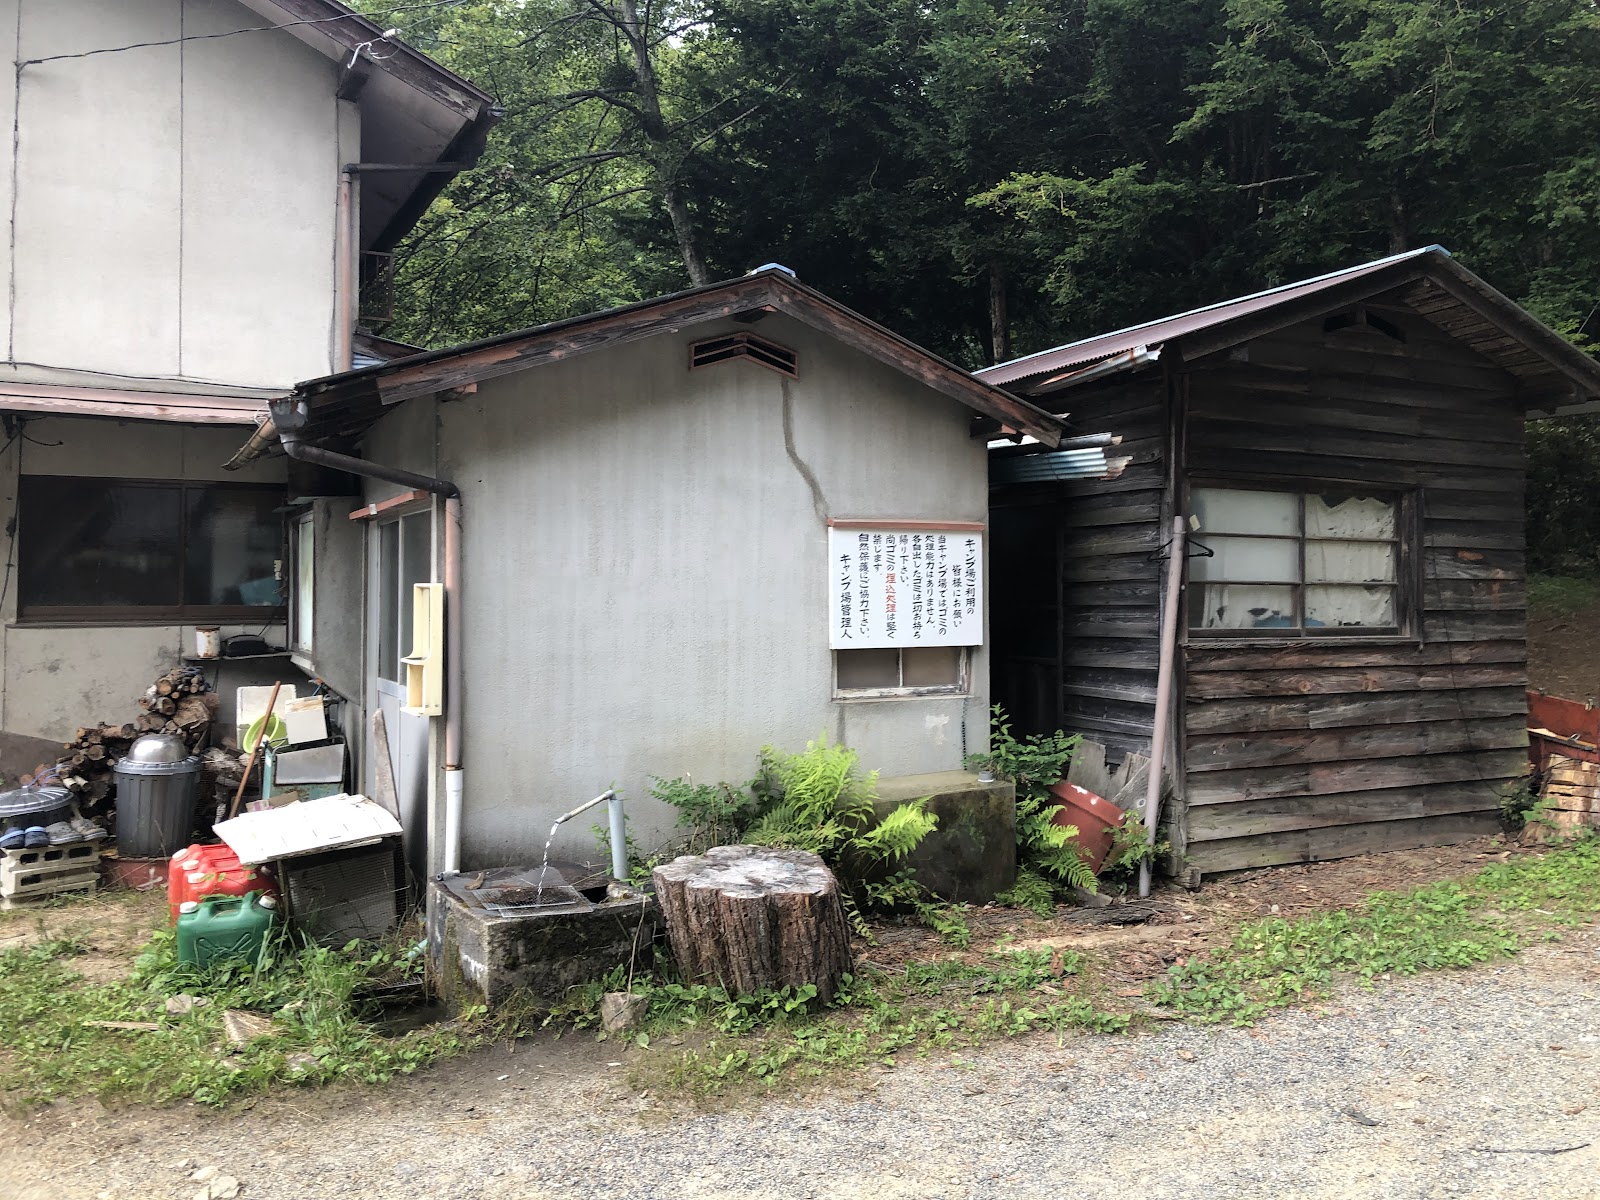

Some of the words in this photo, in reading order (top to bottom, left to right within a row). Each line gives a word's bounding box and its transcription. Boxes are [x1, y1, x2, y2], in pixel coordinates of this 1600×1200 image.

[839, 553, 853, 639] キャンプ場管理人
[937, 534, 948, 636] 当キャンプ場ではゴミの
[951, 564, 963, 628] 皆様にお願い
[964, 538, 977, 615] キャンプ場ご利用の
